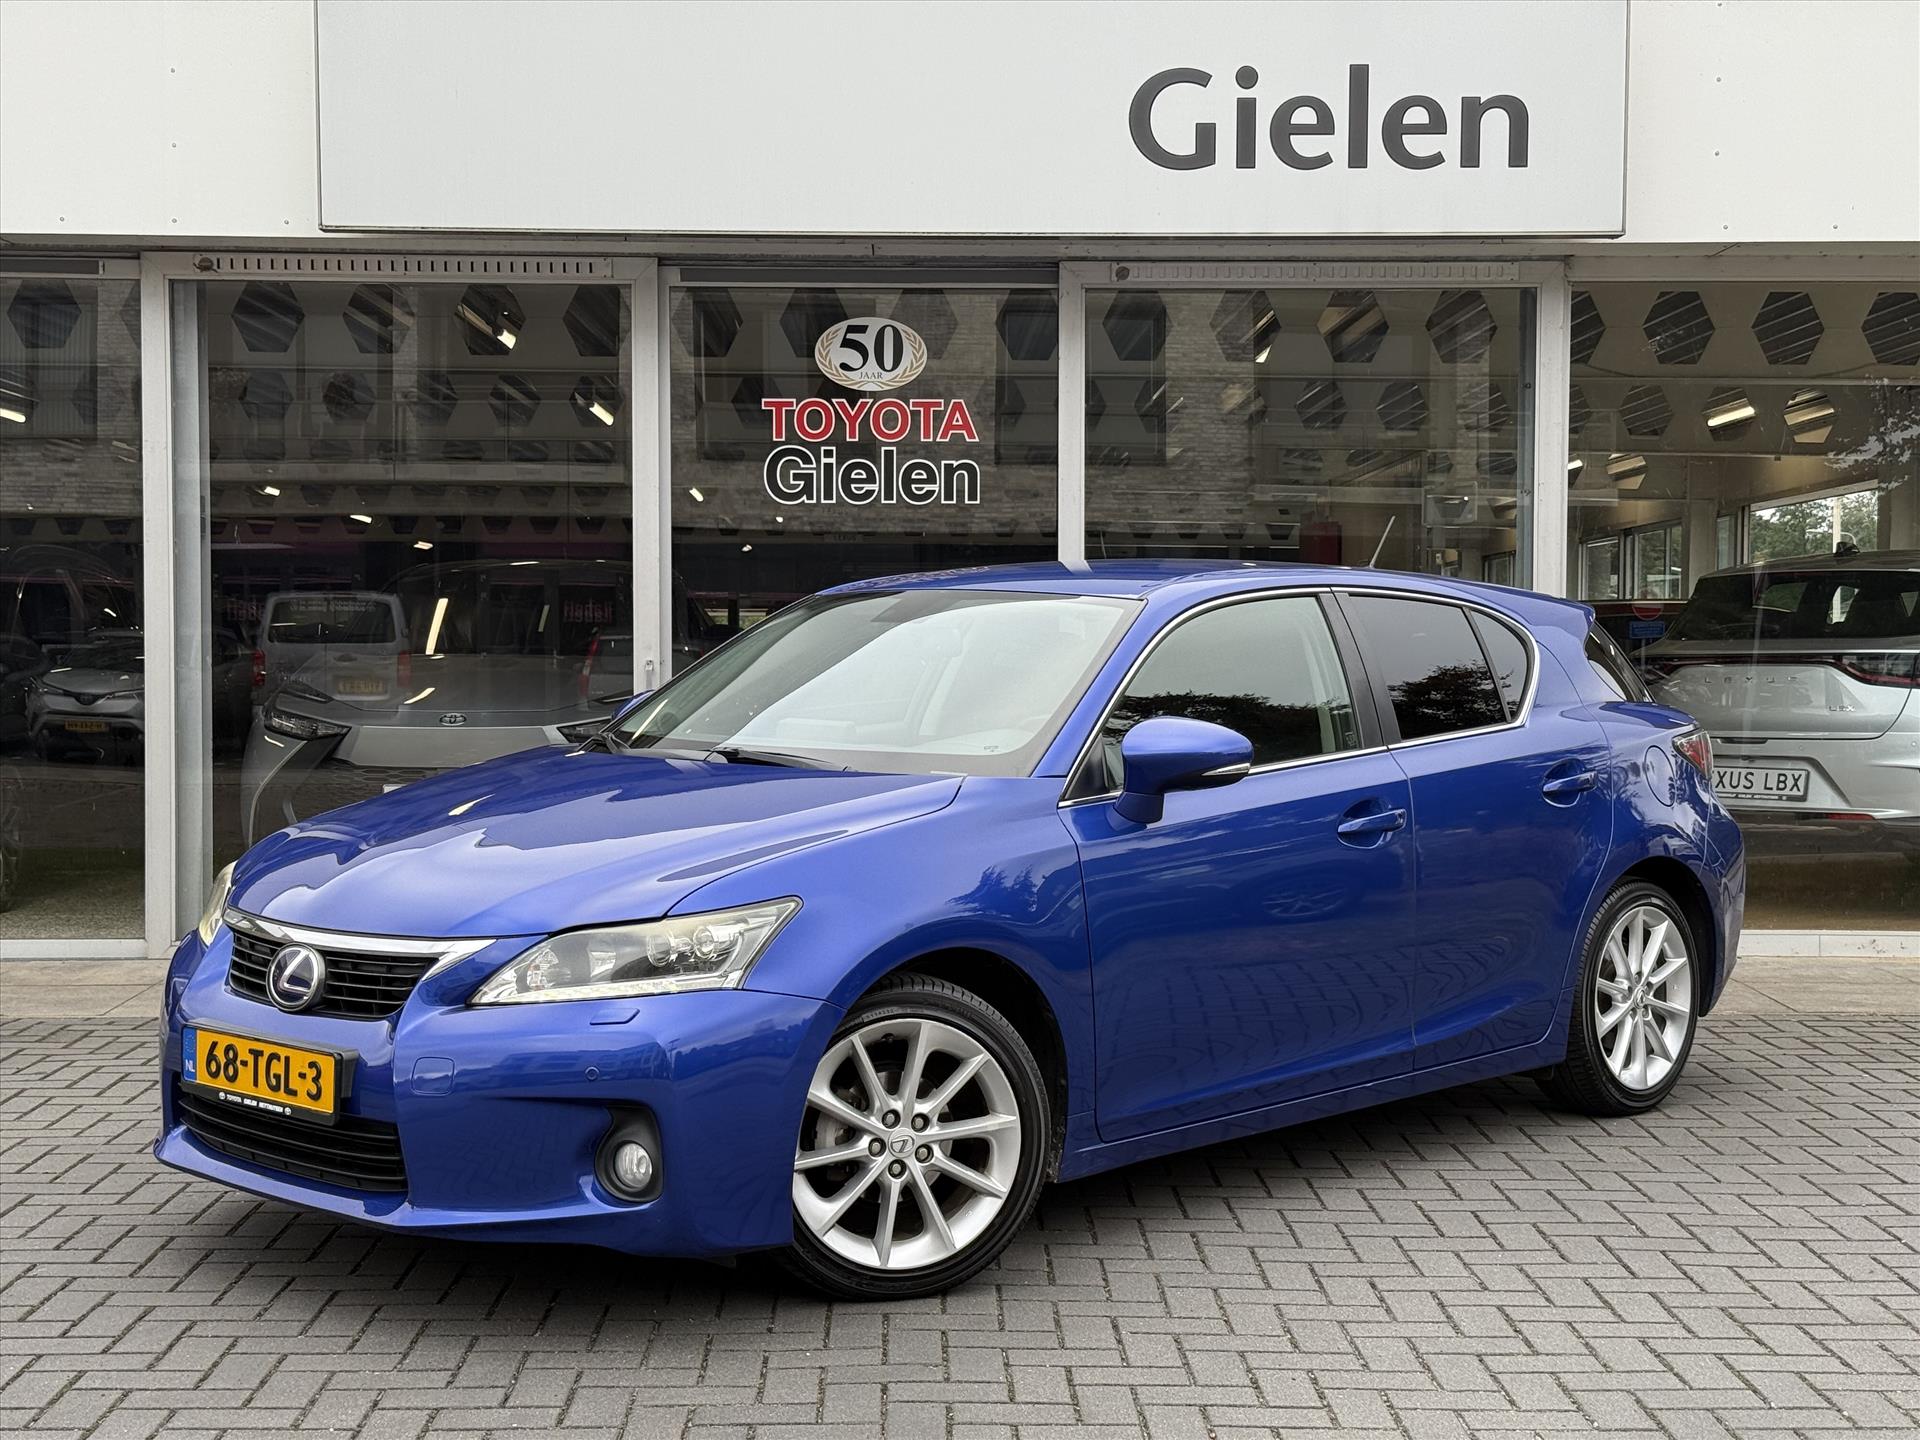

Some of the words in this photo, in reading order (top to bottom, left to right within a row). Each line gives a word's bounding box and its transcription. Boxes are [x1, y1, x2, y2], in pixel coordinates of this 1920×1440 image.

[1128, 64, 1529, 170] Gielen
[838, 324, 904, 372] 50
[858, 371, 884, 380] JAAR
[761, 398, 980, 442] TOYOTA
[763, 445, 981, 505] Gielen
[1712, 770, 1755, 790] XUS
[1763, 772, 1803, 792] LBX
[184, 1059, 196, 1073] NL
[205, 1040, 323, 1102] 68-TGL-3
